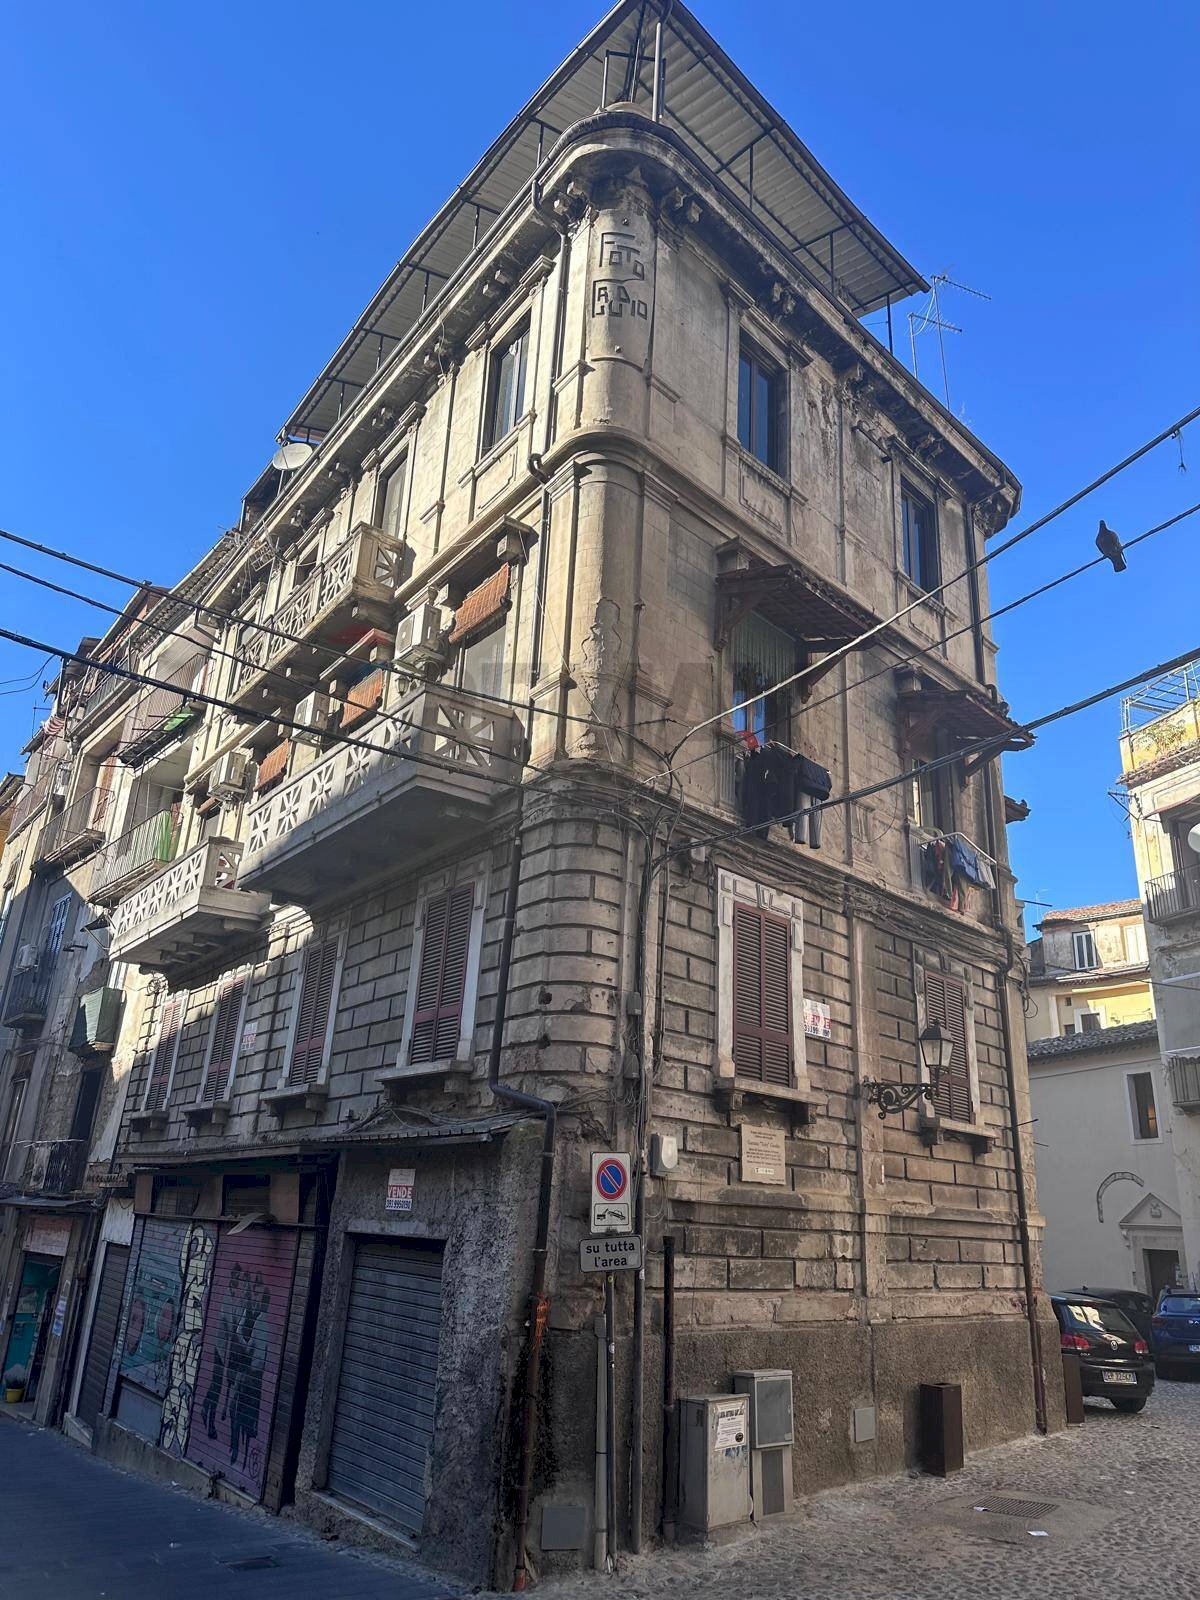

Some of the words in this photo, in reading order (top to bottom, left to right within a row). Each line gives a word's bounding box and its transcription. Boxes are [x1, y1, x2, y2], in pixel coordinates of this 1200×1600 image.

[599, 232, 645, 280] FOTO
[387, 1186, 412, 1199] VENDE
[586, 1245, 599, 1254] su
[605, 1241, 635, 1252] tutta
[594, 1257, 627, 1267] l'area
